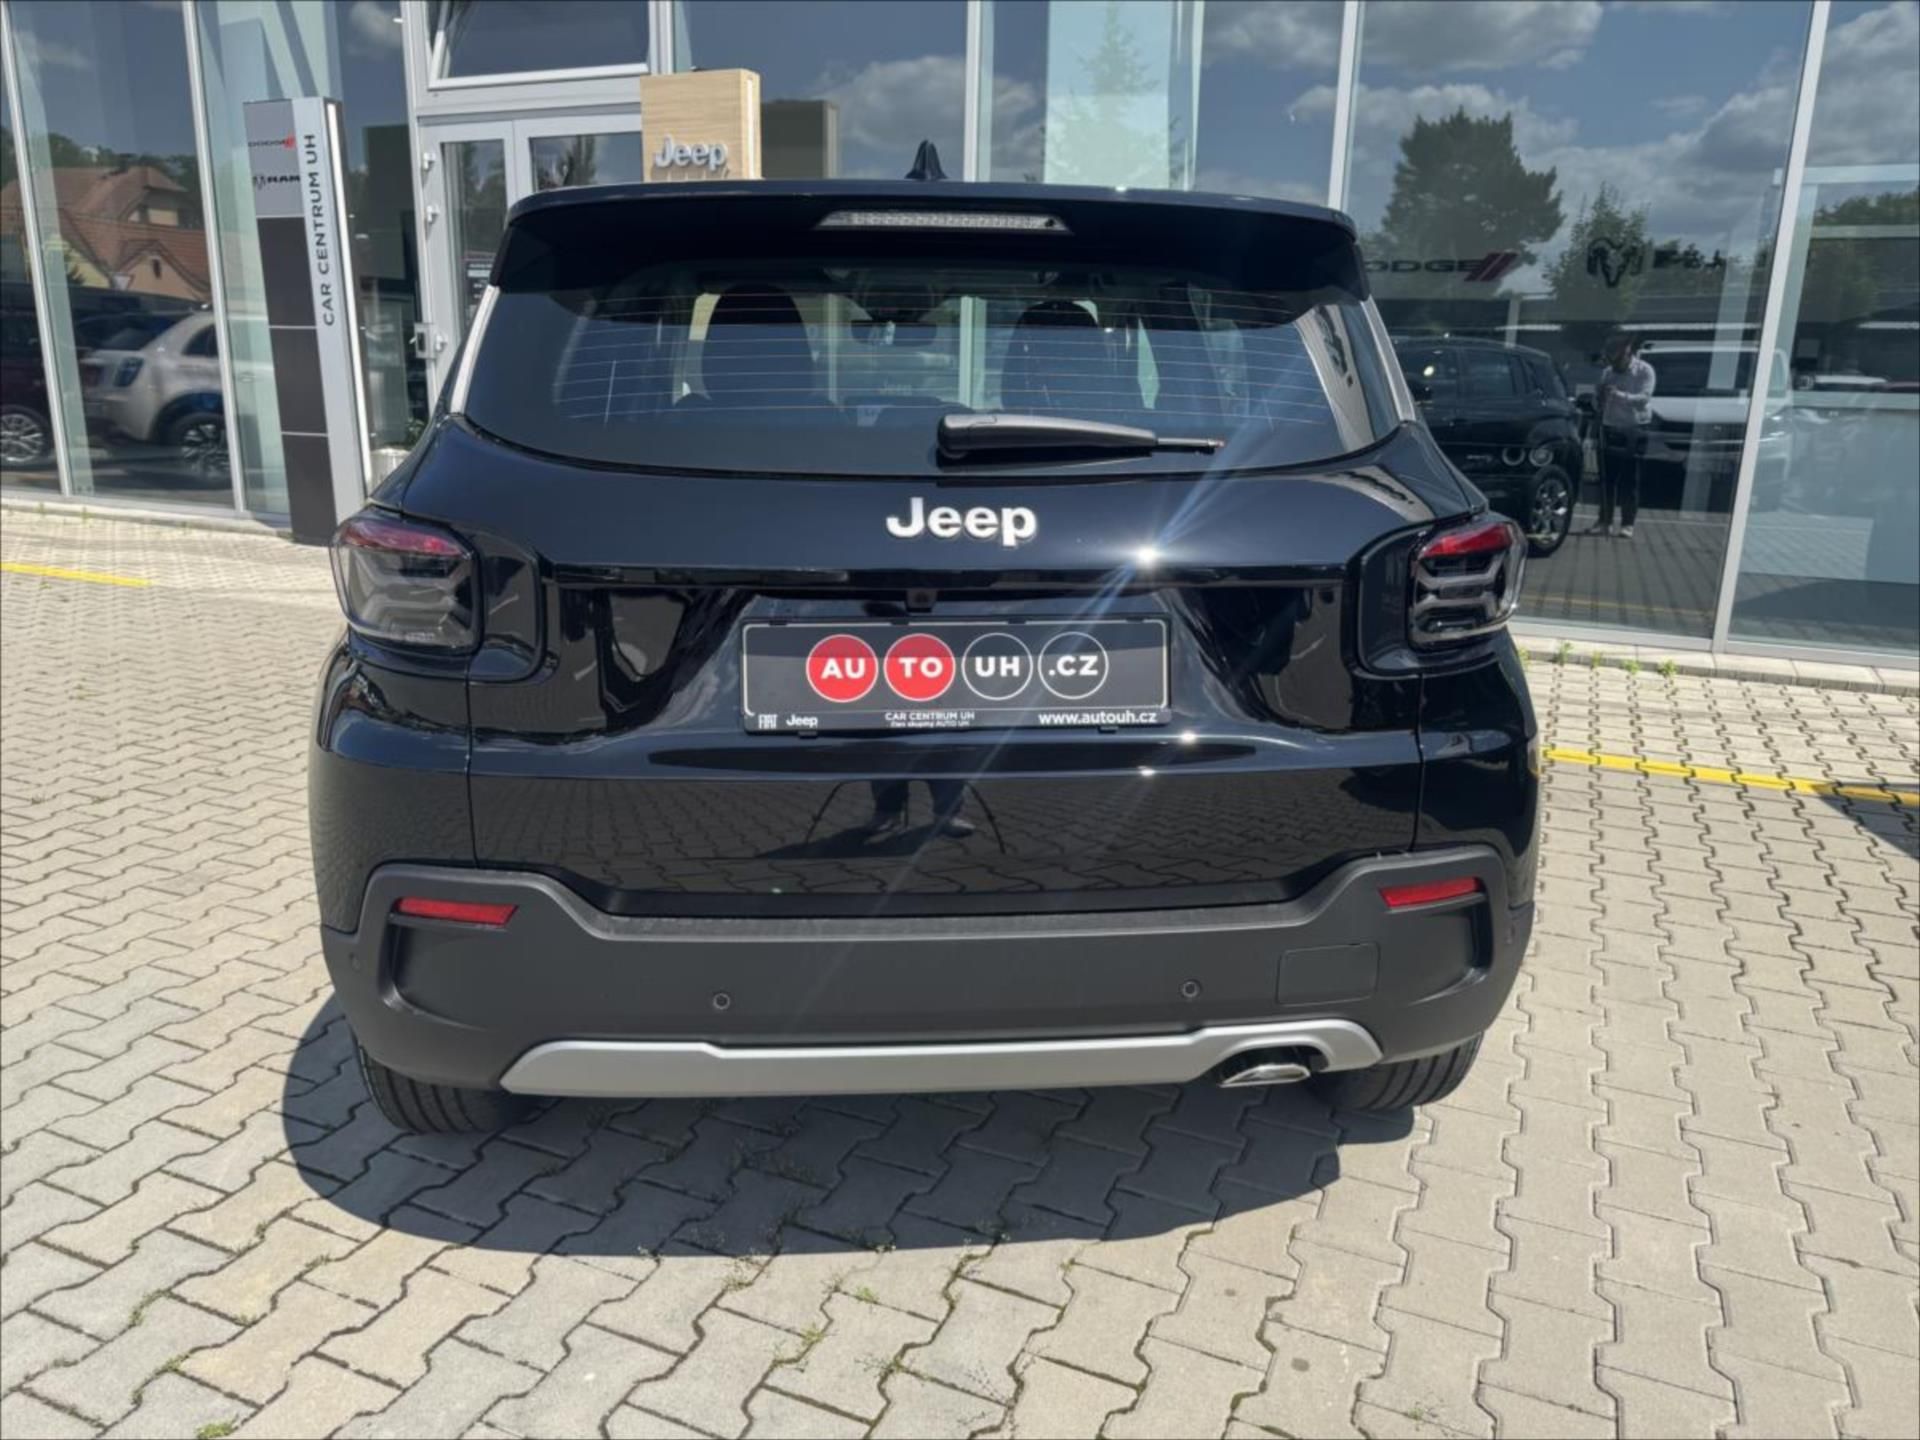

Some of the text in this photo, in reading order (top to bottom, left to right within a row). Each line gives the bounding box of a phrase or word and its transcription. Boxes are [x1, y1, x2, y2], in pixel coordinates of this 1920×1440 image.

[655, 134, 728, 171] Jeep
[304, 134, 335, 326] CAR CENTRUM UH
[886, 497, 1037, 546] Jeep
[821, 655, 1098, 679] AU TO UH .CZ
[786, 713, 818, 729] Jeep
[885, 711, 975, 721] CAR CENTRUM UH
[1038, 710, 1158, 725] www.autouh.cz
